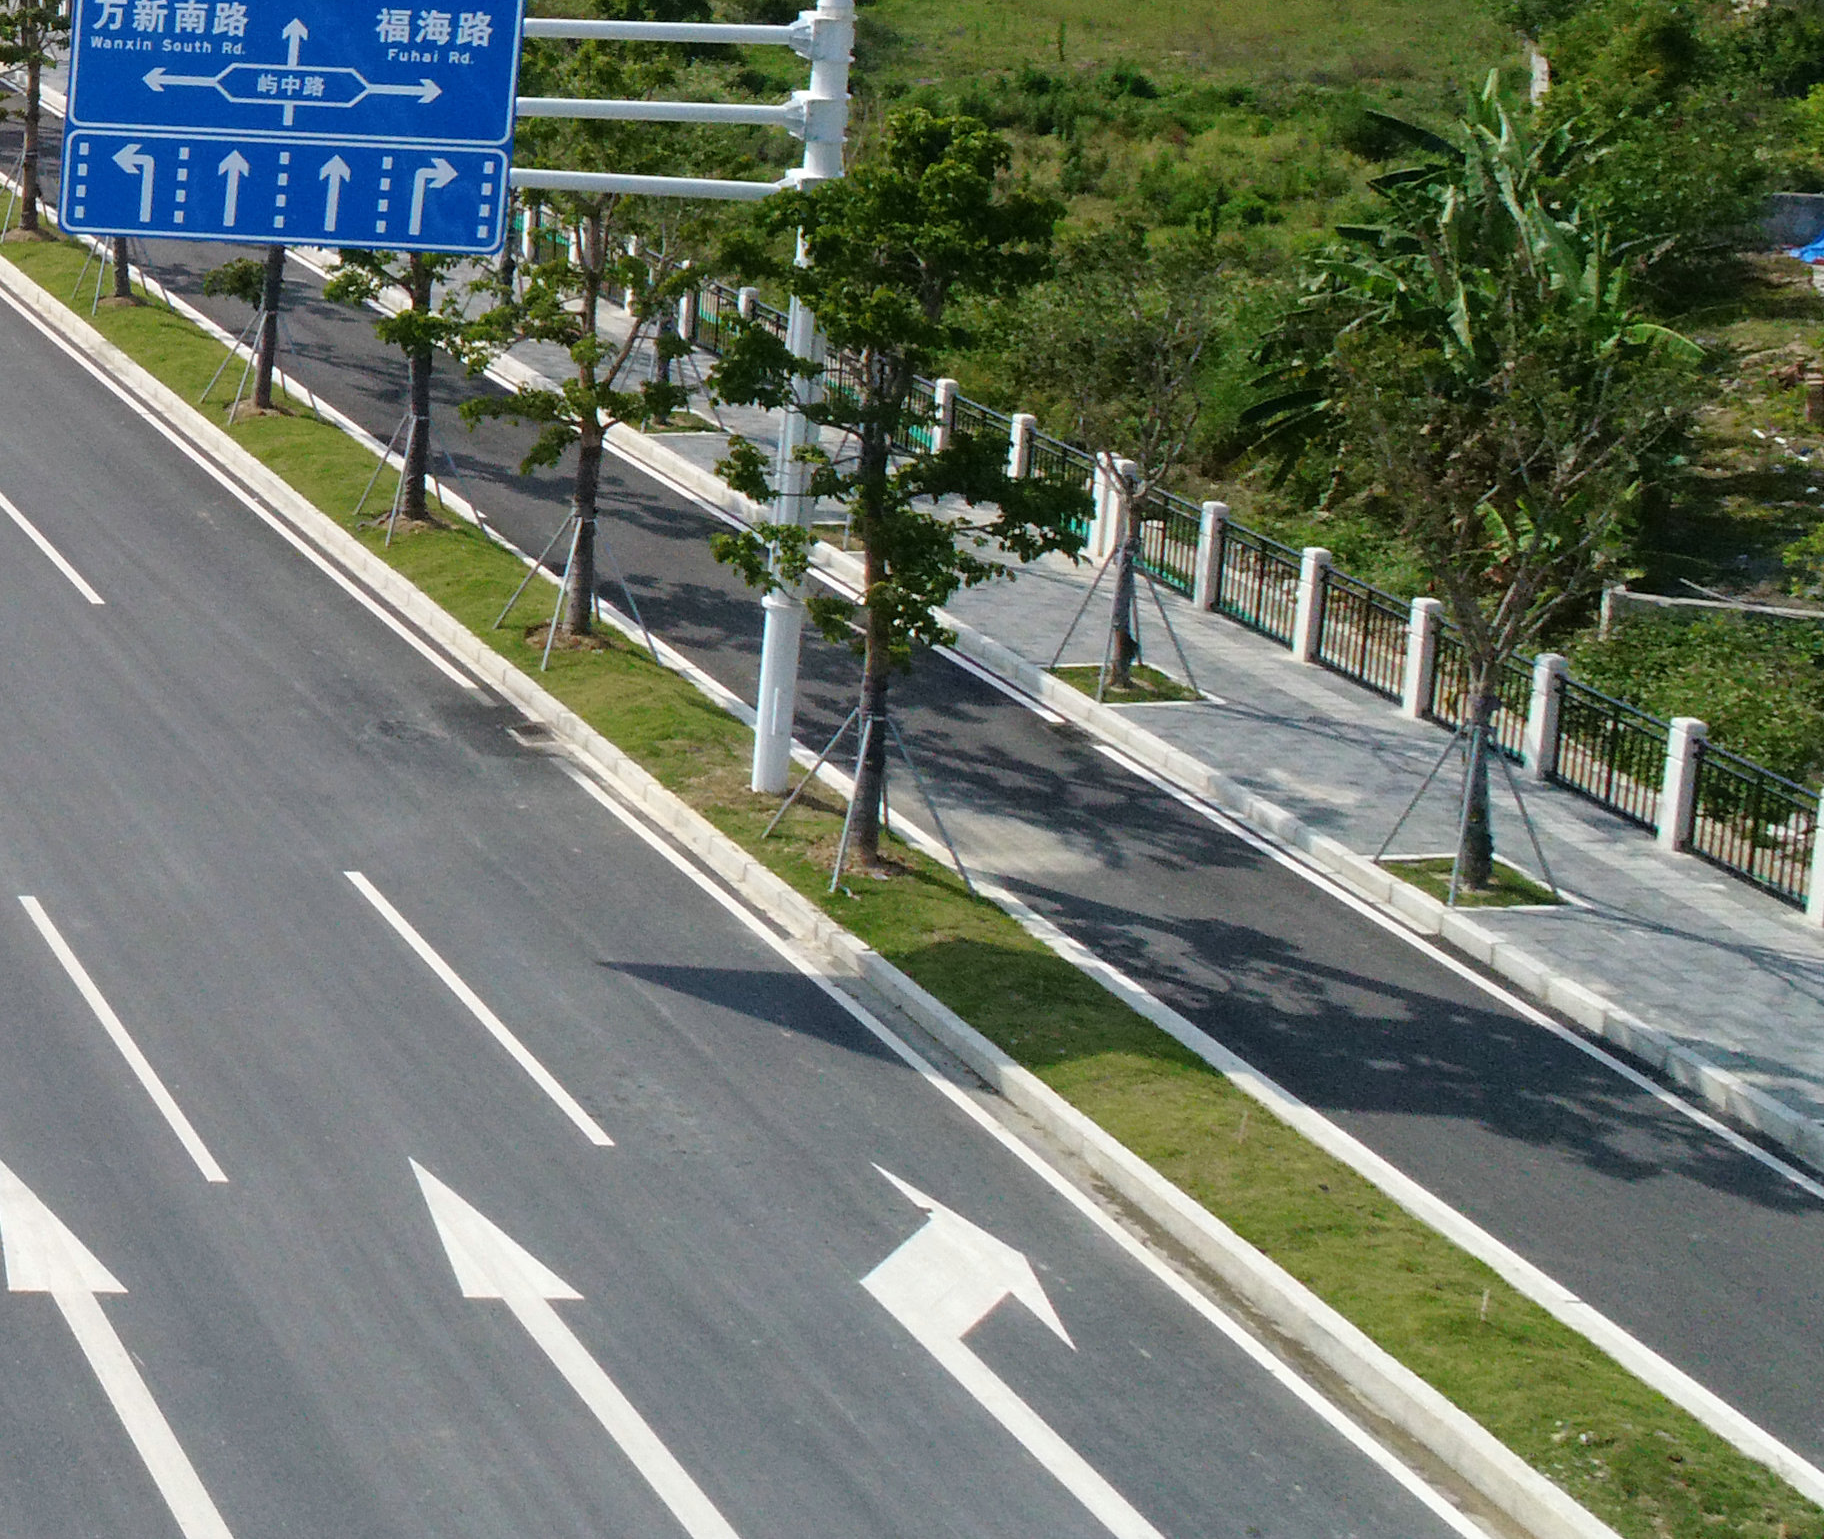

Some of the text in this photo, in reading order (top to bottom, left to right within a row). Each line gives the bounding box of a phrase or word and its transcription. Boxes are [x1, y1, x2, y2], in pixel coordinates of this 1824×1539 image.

[375, 8, 493, 47] 福海路
[90, 36, 246, 55] Wanxin South Rd.
[387, 49, 474, 64] Fuhai Rd.
[257, 73, 325, 97] 屿中路
